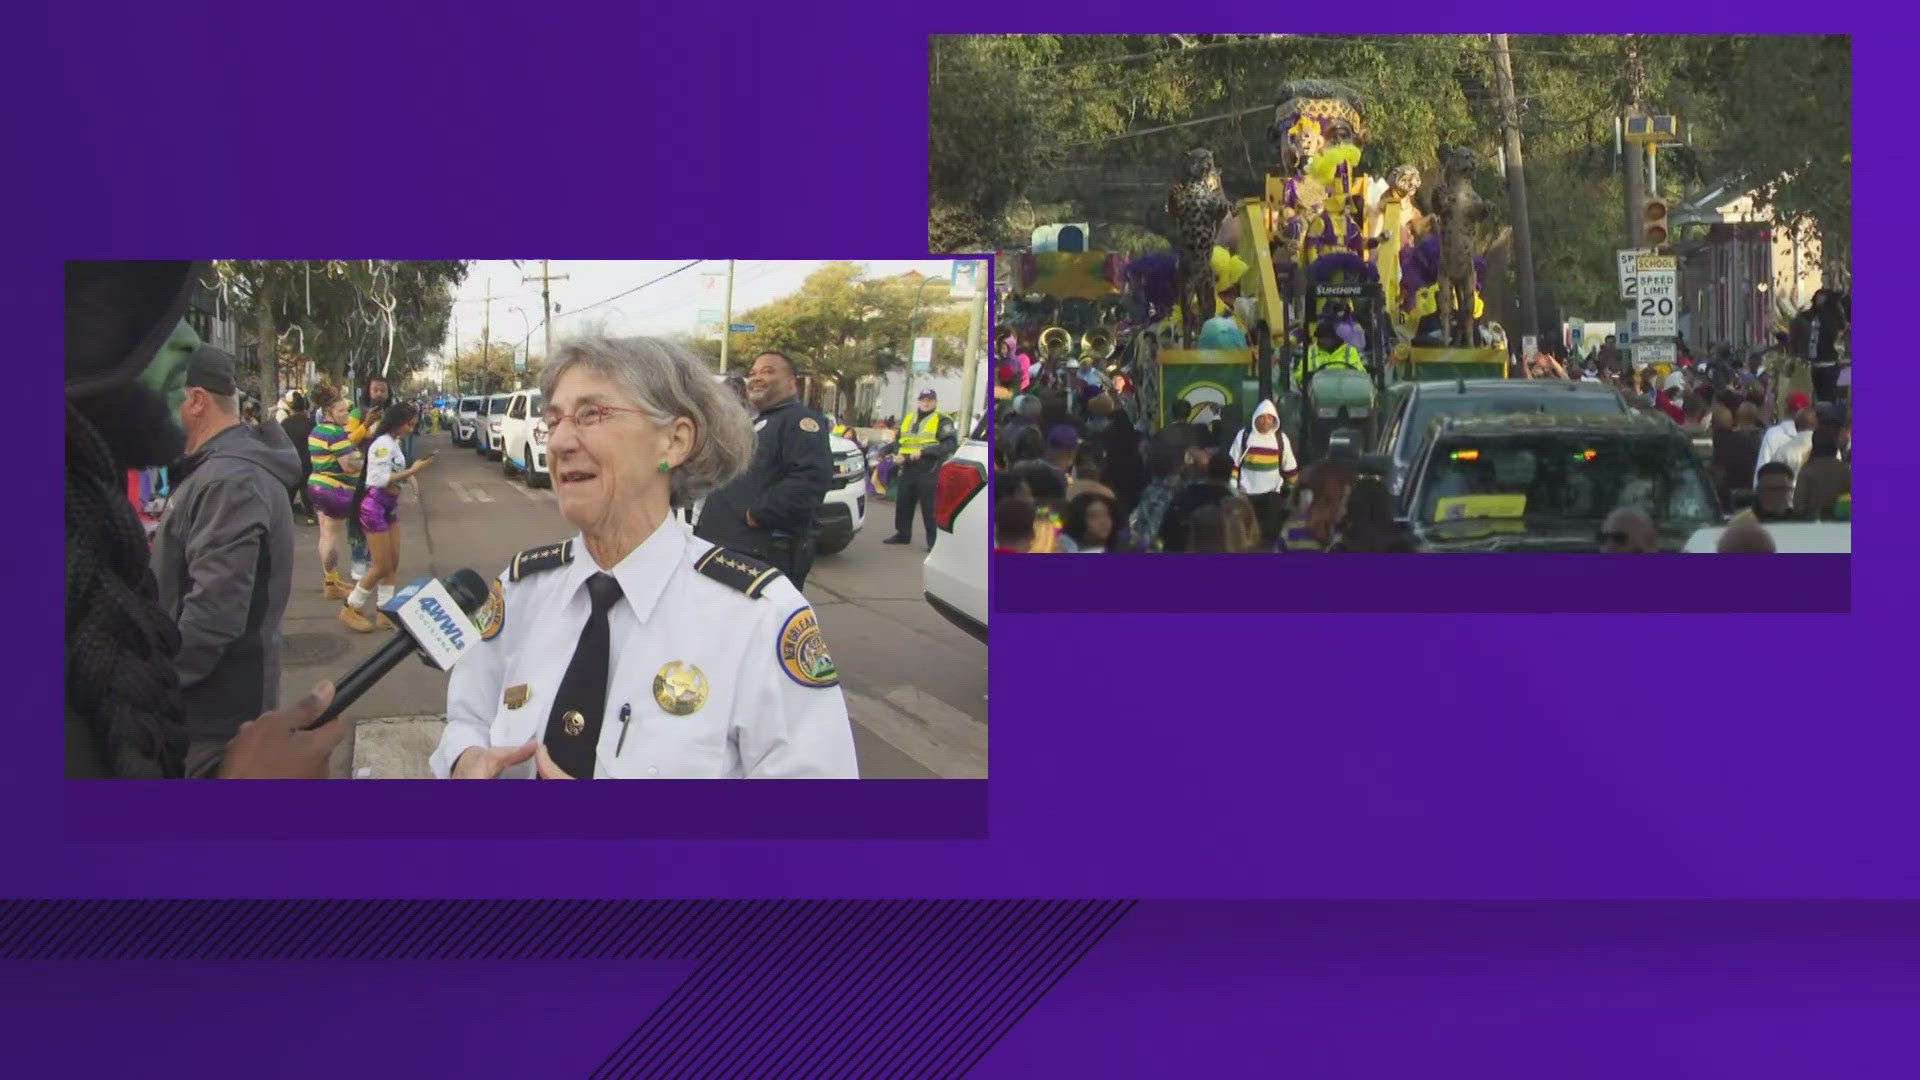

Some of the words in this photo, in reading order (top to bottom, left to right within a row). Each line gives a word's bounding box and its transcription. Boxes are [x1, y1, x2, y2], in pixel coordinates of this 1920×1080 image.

[1638, 258, 1674, 268] SCHOOL
[1624, 277, 1637, 295] 2
[1640, 276, 1674, 286] SPEED
[1316, 285, 1362, 295] SUNSHINE
[1643, 286, 1671, 296] LIMIT
[1641, 298, 1673, 316] 20
[783, 641, 796, 660] NEW
